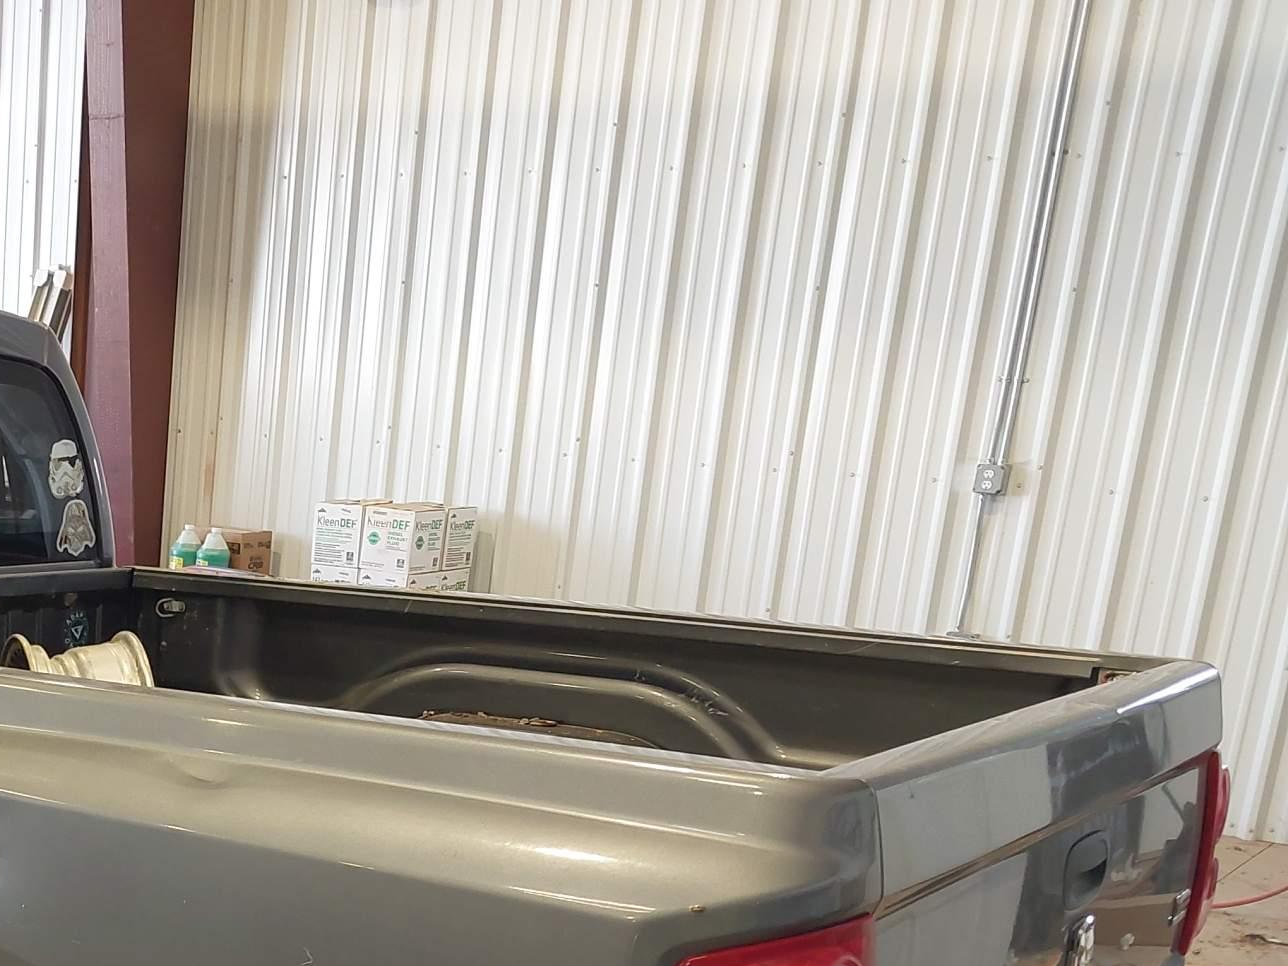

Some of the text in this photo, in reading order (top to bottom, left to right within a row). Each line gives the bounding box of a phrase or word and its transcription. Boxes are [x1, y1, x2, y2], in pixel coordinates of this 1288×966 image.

[317, 515, 358, 529] KleenDEF
[367, 516, 411, 530] KleenDEF
[415, 519, 443, 532] KleenDEF
[450, 519, 475, 531] KleenDEF
